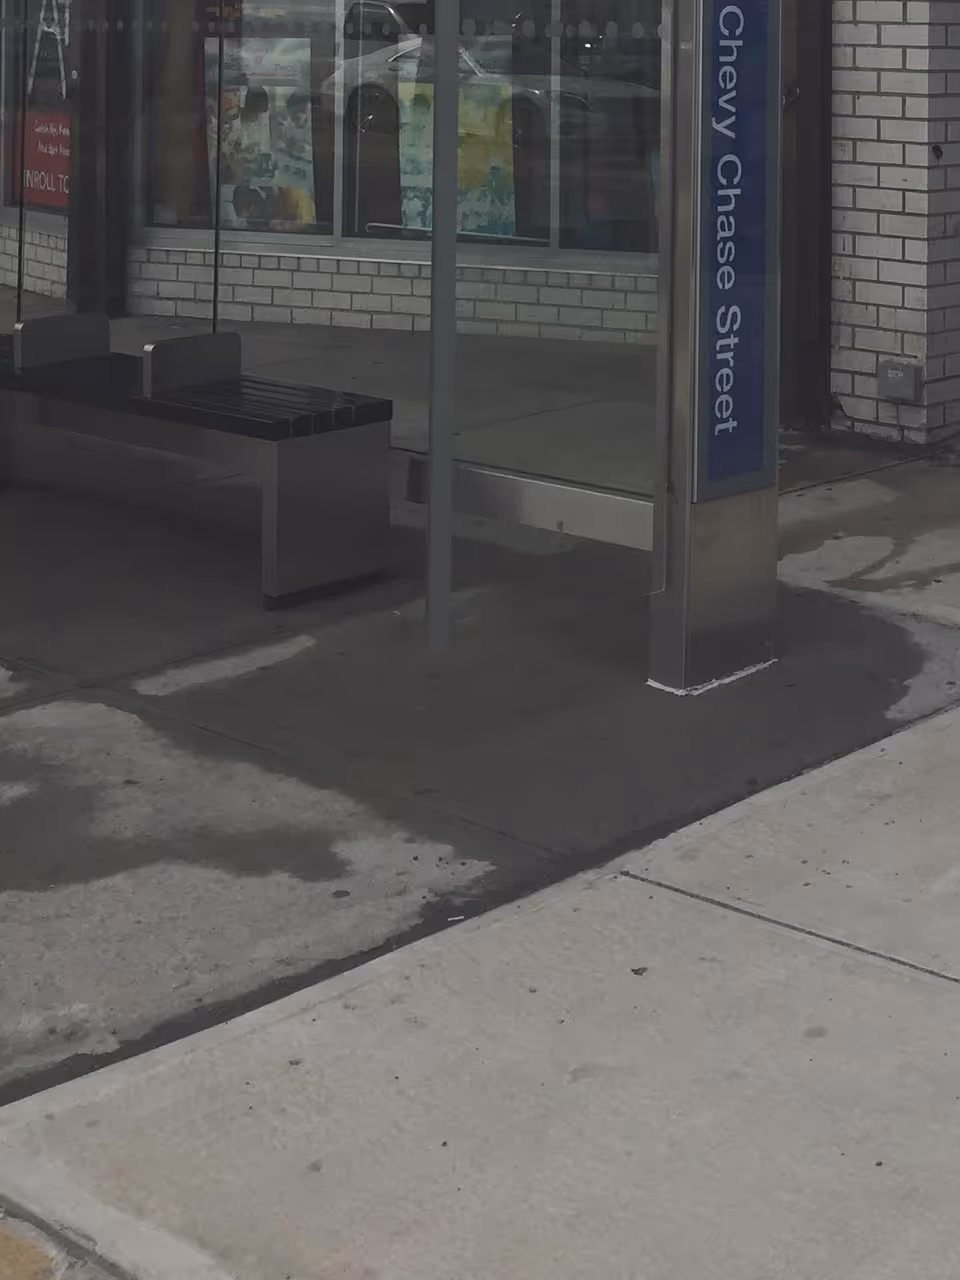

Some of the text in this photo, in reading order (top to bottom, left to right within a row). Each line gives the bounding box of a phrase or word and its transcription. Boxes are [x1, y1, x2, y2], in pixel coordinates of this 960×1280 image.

[712, 4, 745, 138] Chevy
[715, 154, 742, 291] Chase
[714, 304, 742, 437] Street
